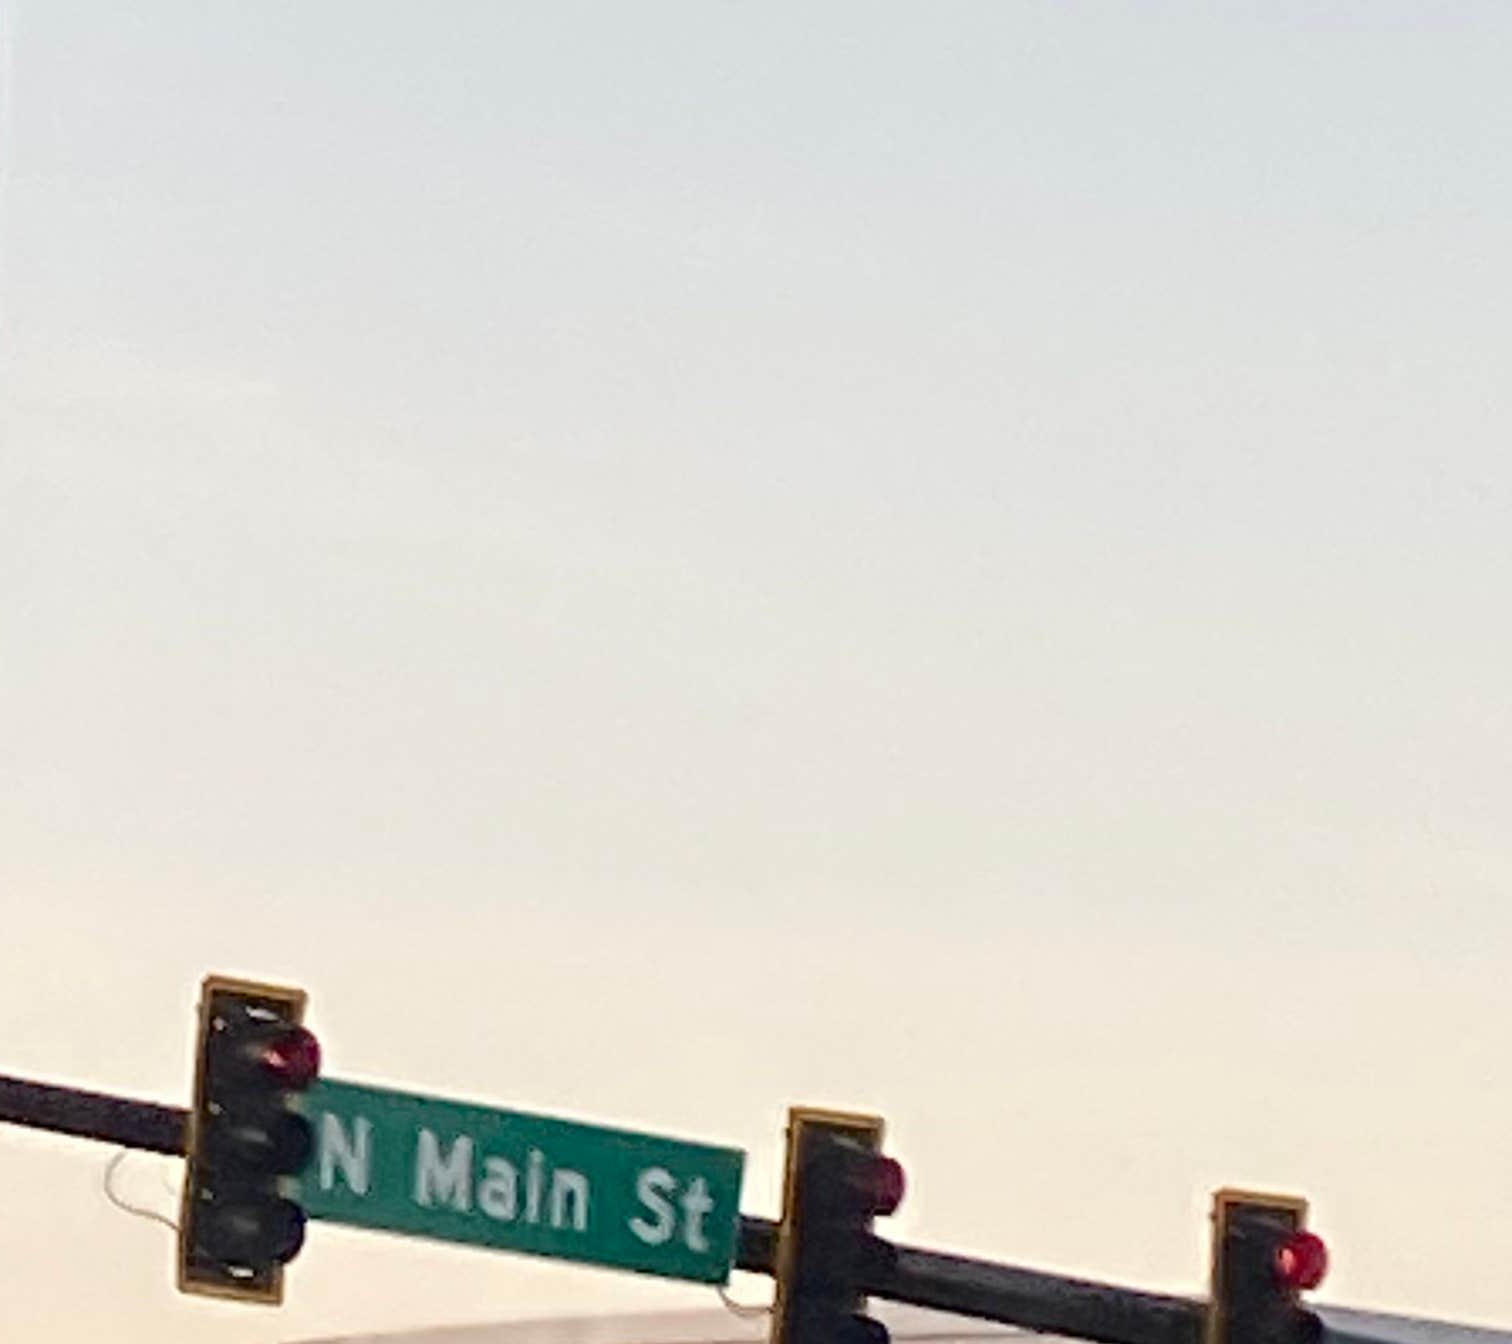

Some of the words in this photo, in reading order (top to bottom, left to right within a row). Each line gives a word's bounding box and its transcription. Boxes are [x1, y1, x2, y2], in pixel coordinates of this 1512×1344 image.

[317, 1111, 371, 1197] N
[413, 1128, 590, 1233] Main
[628, 1165, 715, 1253] St
